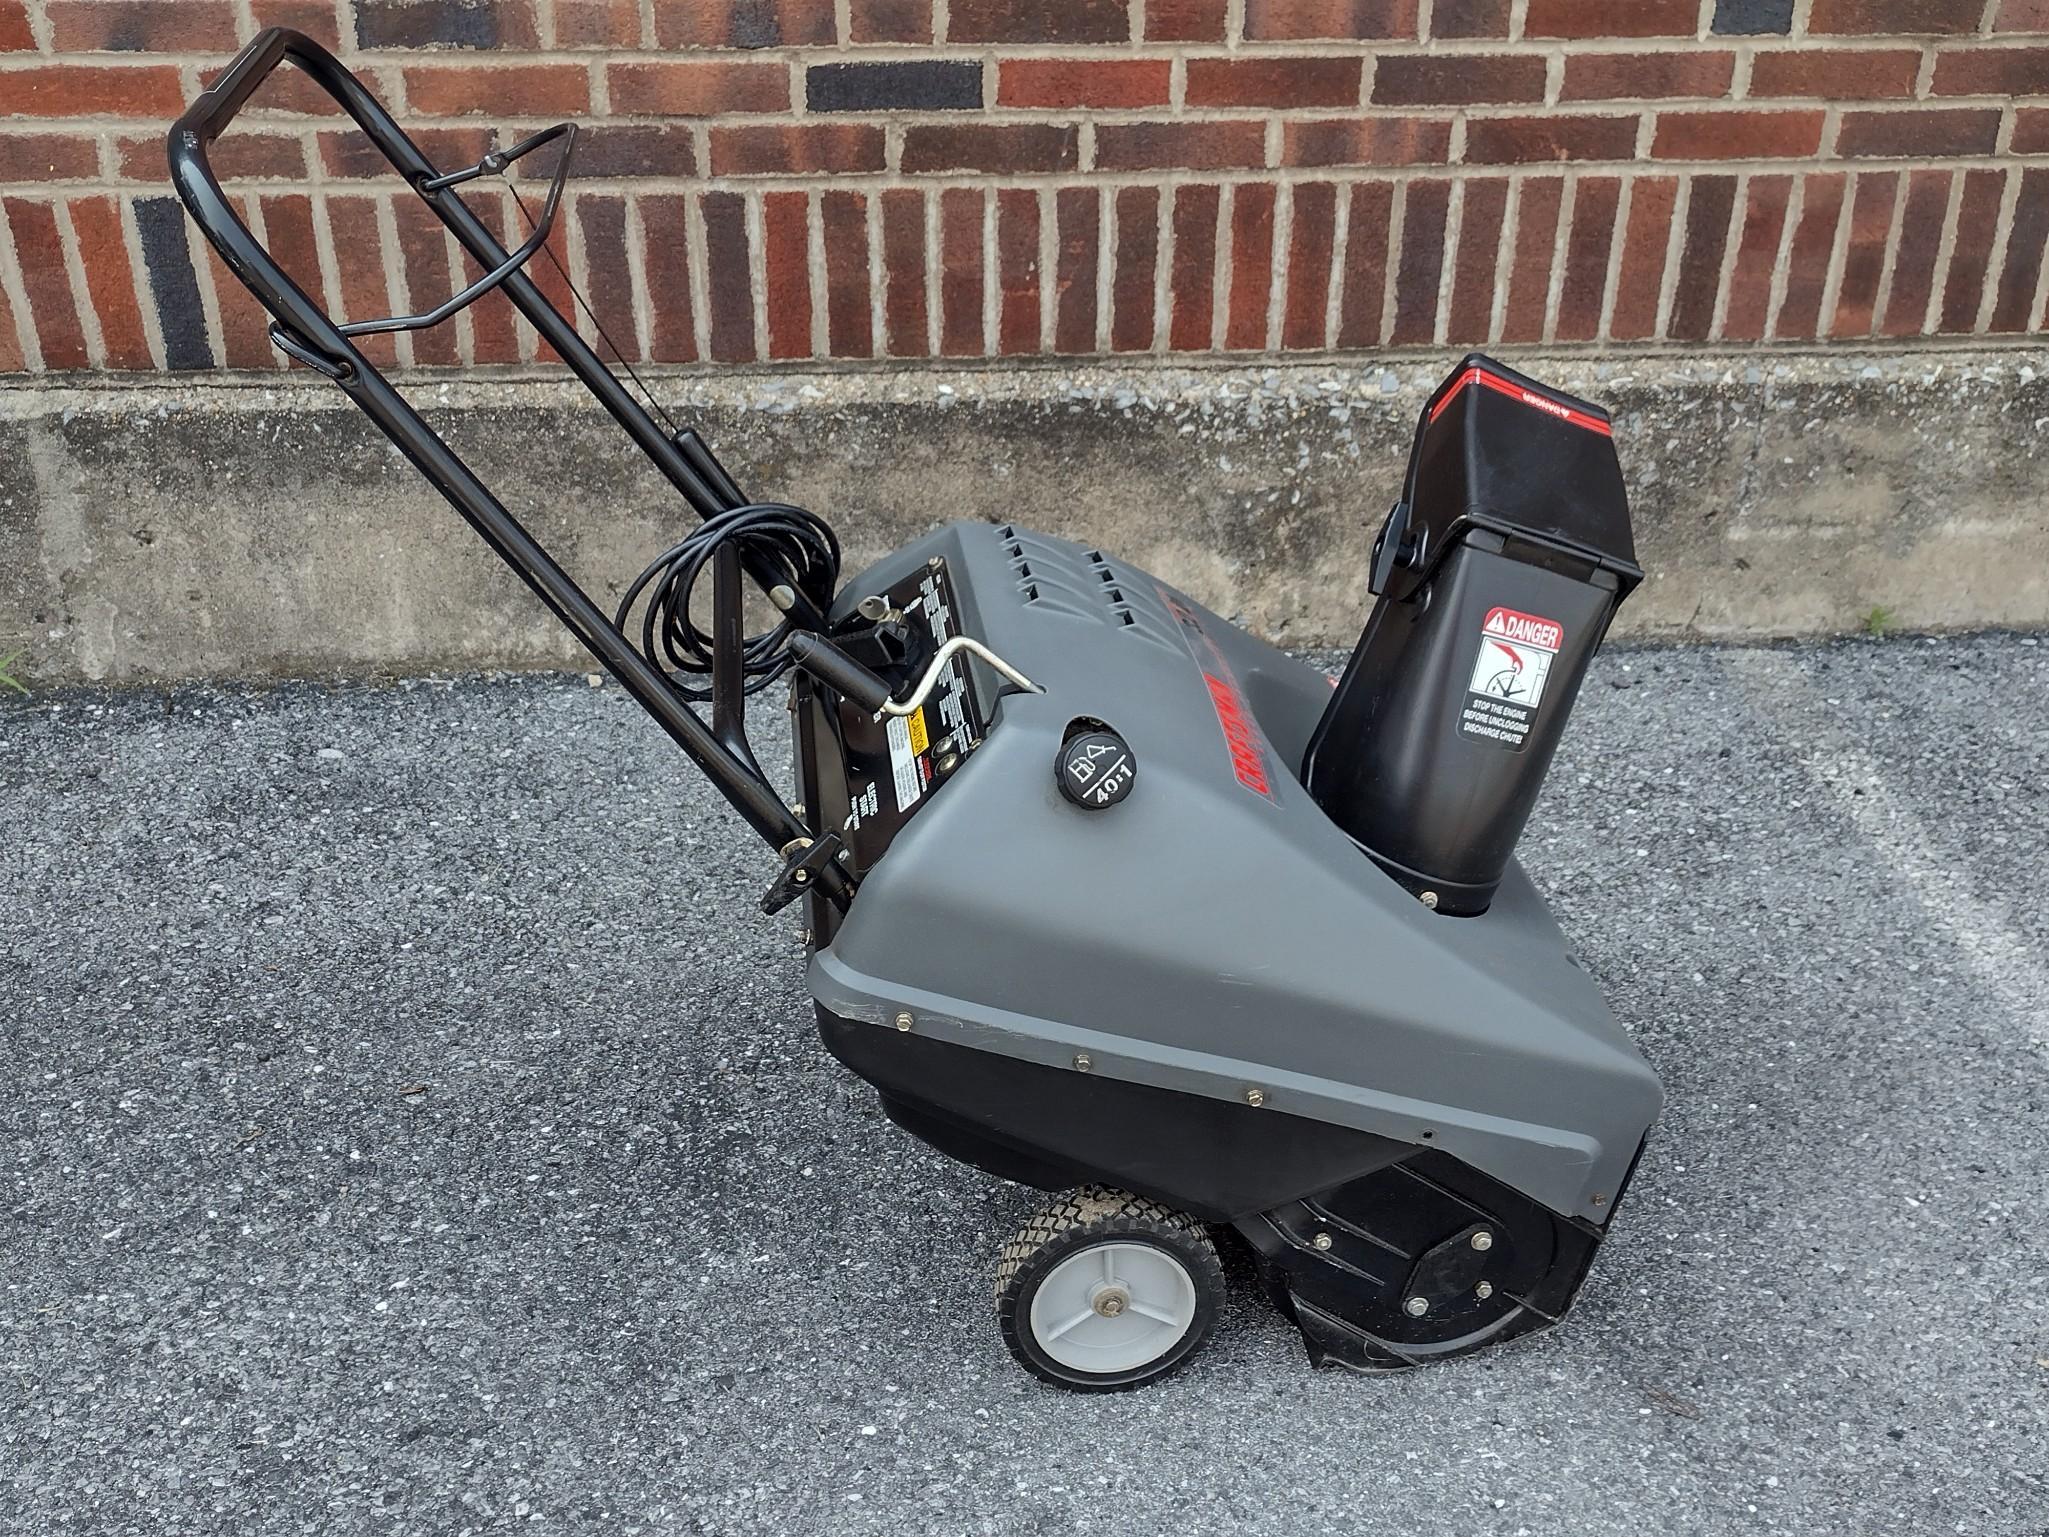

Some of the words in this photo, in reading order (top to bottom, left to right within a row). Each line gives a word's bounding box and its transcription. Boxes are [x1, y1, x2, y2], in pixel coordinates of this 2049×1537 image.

[1505, 616, 1559, 648] DANGER
[1463, 709, 1488, 723] BEFORE
[1489, 715, 1530, 734] UNCLOGGING
[1472, 699, 1490, 711] STOP
[1491, 703, 1503, 714] THE
[1503, 706, 1527, 720] ENGINE
[911, 718, 924, 754] CAUTION
[1463, 722, 1500, 739] DISCHARGE
[1500, 731, 1523, 745] CHUTE!
[1096, 764, 1133, 803] 40:1
[859, 794, 869, 818] START
[867, 781, 879, 816] ELECTRIC
